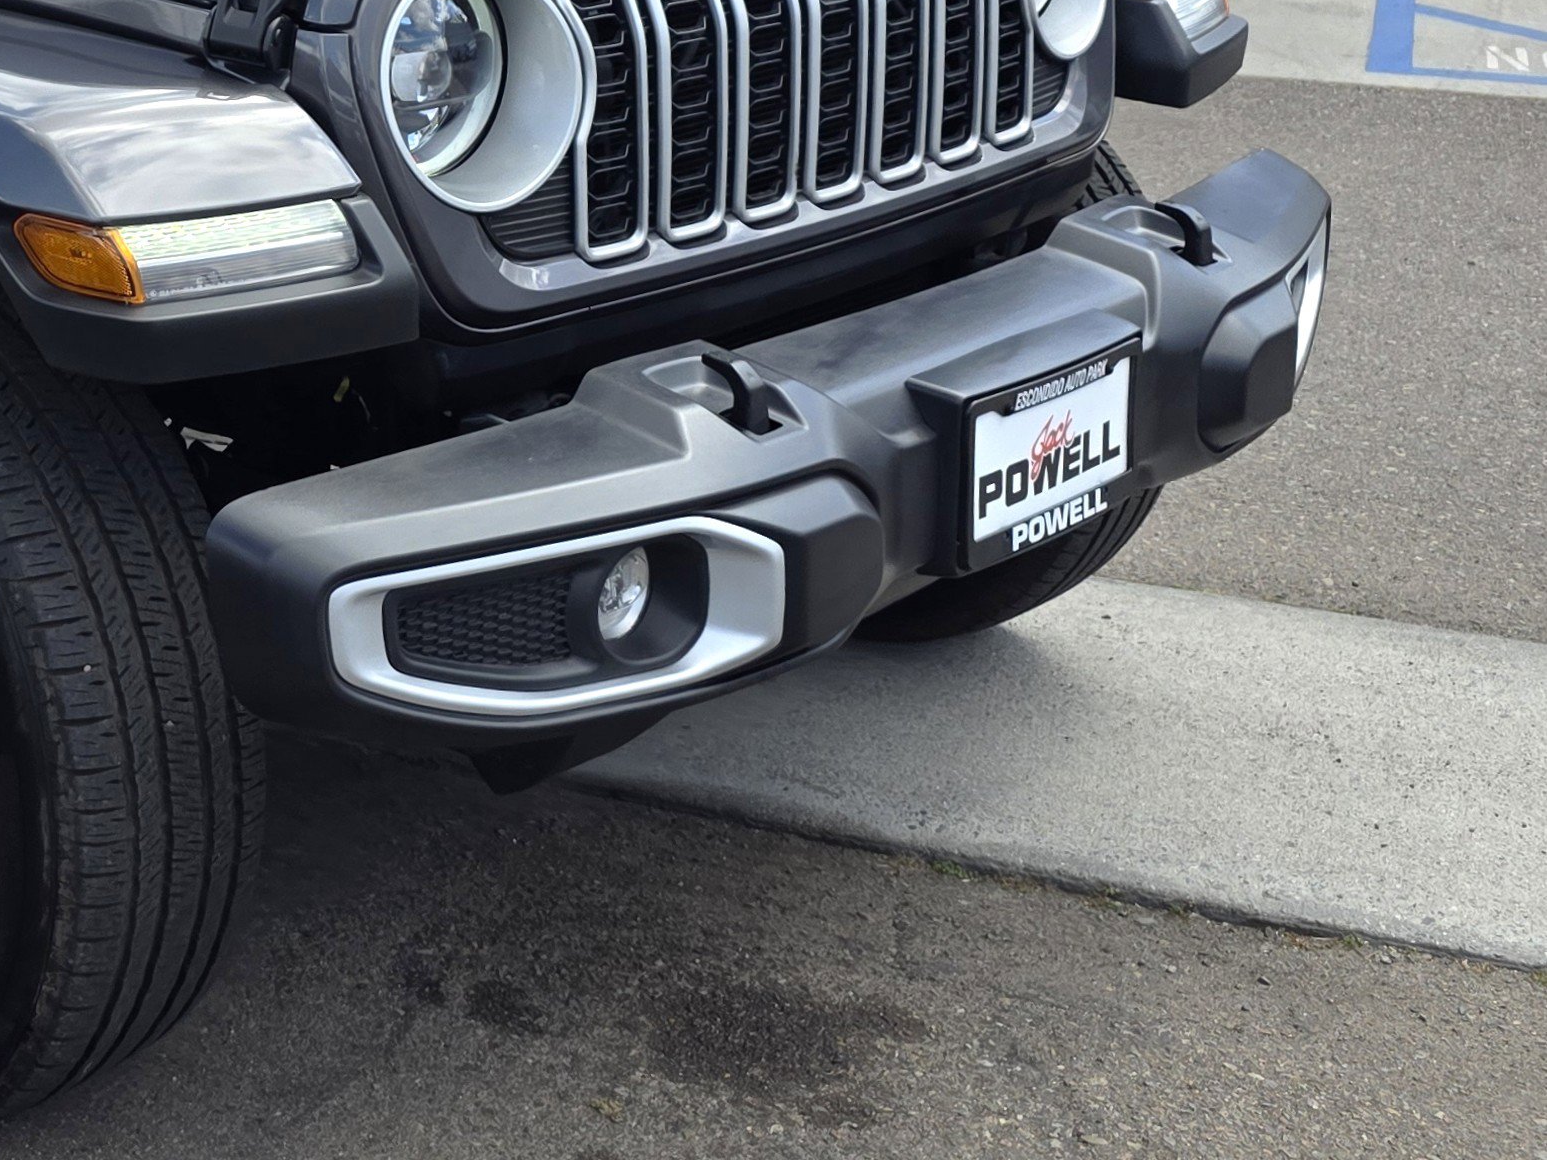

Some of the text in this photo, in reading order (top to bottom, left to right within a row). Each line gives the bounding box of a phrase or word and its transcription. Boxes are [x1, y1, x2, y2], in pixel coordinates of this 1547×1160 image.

[1014, 358, 1109, 411] ESCONDIDO AUTO PARK
[978, 420, 1121, 520] POWELL
[1031, 409, 1075, 482] Jack
[1012, 487, 1108, 552] POWELL
